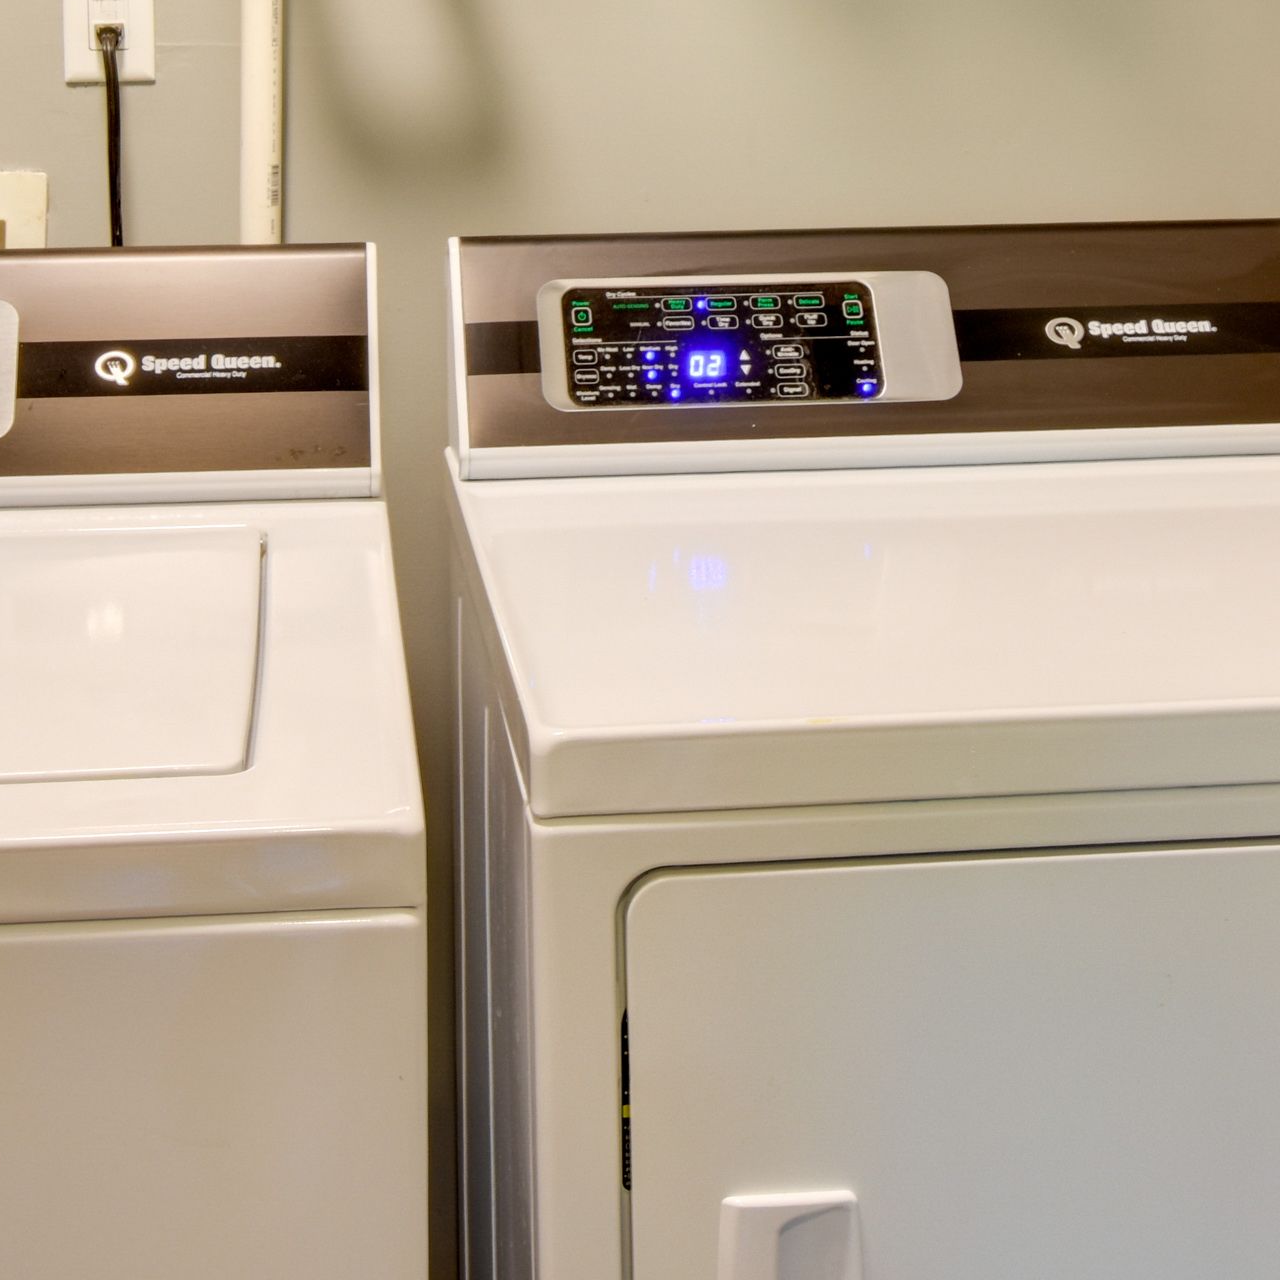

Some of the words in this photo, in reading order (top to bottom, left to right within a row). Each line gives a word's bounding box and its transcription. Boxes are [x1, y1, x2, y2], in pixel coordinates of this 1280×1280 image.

[1088, 320, 1148, 338] Speed
[142, 355, 206, 373] Speed
[689, 355, 721, 377] 02
